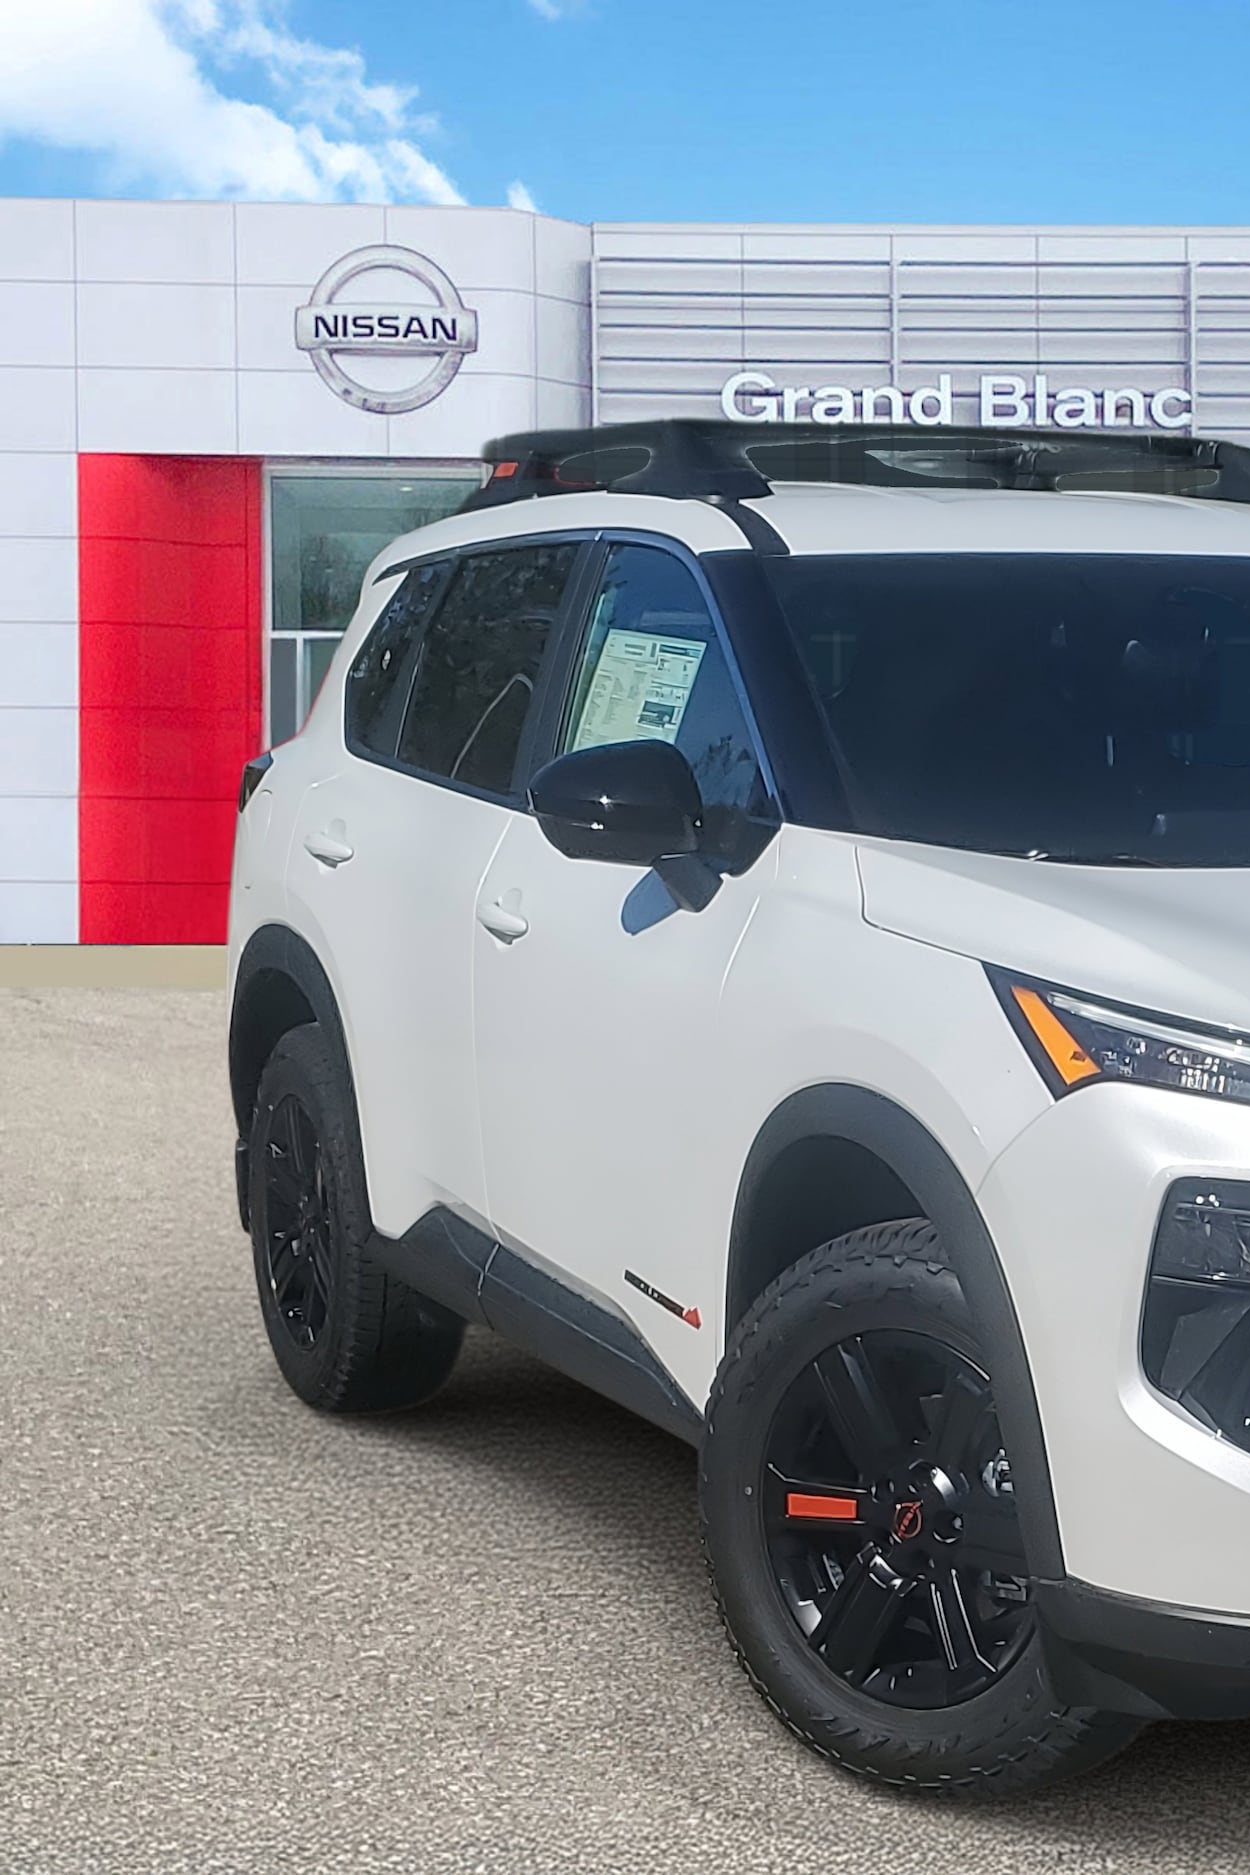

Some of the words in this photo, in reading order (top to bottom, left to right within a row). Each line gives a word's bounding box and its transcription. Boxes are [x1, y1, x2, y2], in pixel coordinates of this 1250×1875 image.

[314, 314, 457, 341] NISSAN
[720, 371, 952, 425] Grand
[979, 373, 1193, 428] Blanc
